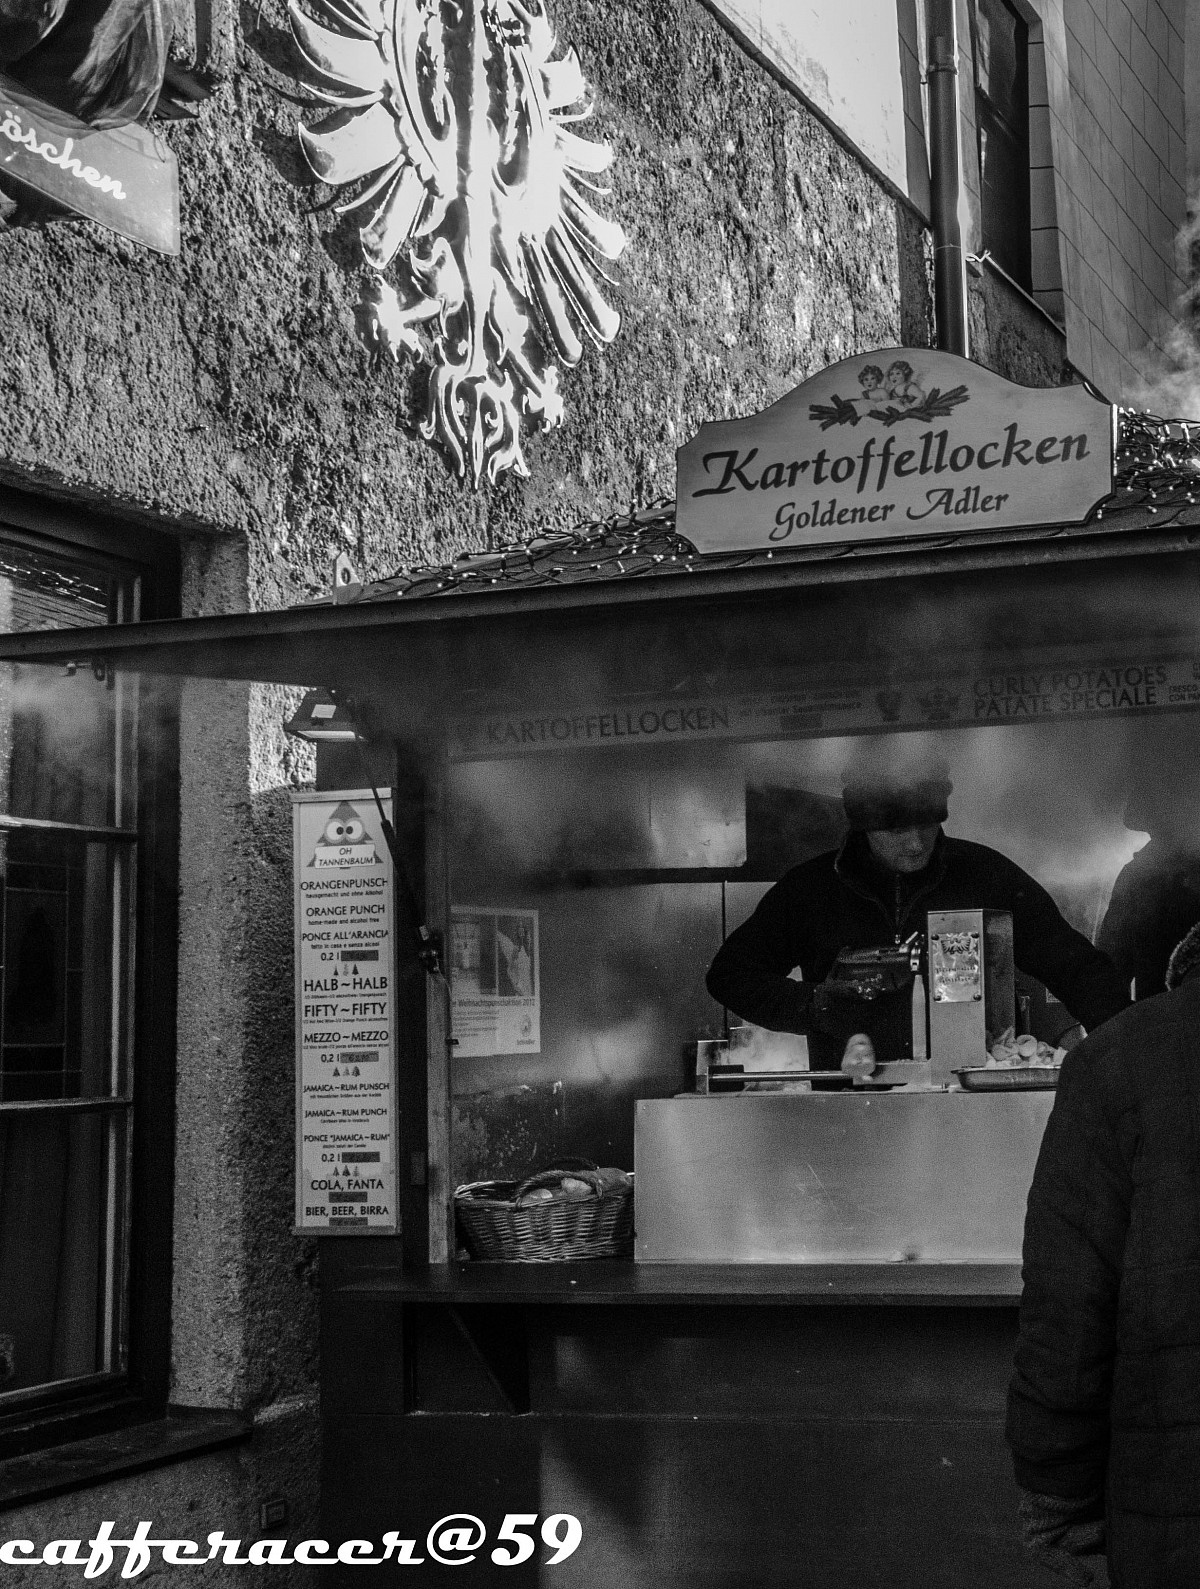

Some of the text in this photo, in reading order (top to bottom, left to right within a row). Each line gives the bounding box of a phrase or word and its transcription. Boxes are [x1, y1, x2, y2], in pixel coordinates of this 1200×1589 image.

[0, 110, 127, 200] öschen
[692, 422, 1090, 497] Kartoffellocken
[769, 485, 1010, 542] Goldener Adler
[974, 665, 1168, 699] CURLY POTATOES
[974, 687, 1157, 718] PATATE SPECIALE
[488, 706, 729, 744] KARTOFFELLOCKEN
[339, 847, 353, 856] OH
[319, 857, 374, 867] TANNENBAUM
[300, 877, 388, 891] ORANGENPUNSCH
[306, 904, 385, 917] ORANGE PUNCH
[302, 931, 332, 941] PONCE
[304, 978, 339, 992] HALB
[352, 976, 388, 990] HALB
[304, 1003, 339, 1017] FIFTY
[352, 1002, 387, 1016] FIFTY
[304, 1032, 341, 1043] MEZZO
[351, 1030, 389, 1042] MEZZO
[359, 1082, 390, 1090] PUNSCH
[360, 1108, 388, 1116] PUNCH
[303, 1134, 328, 1143] PONCE
[310, 1179, 384, 1191] COLA, FANTA
[305, 1205, 389, 1217] BIER, BEER, BIRRA
